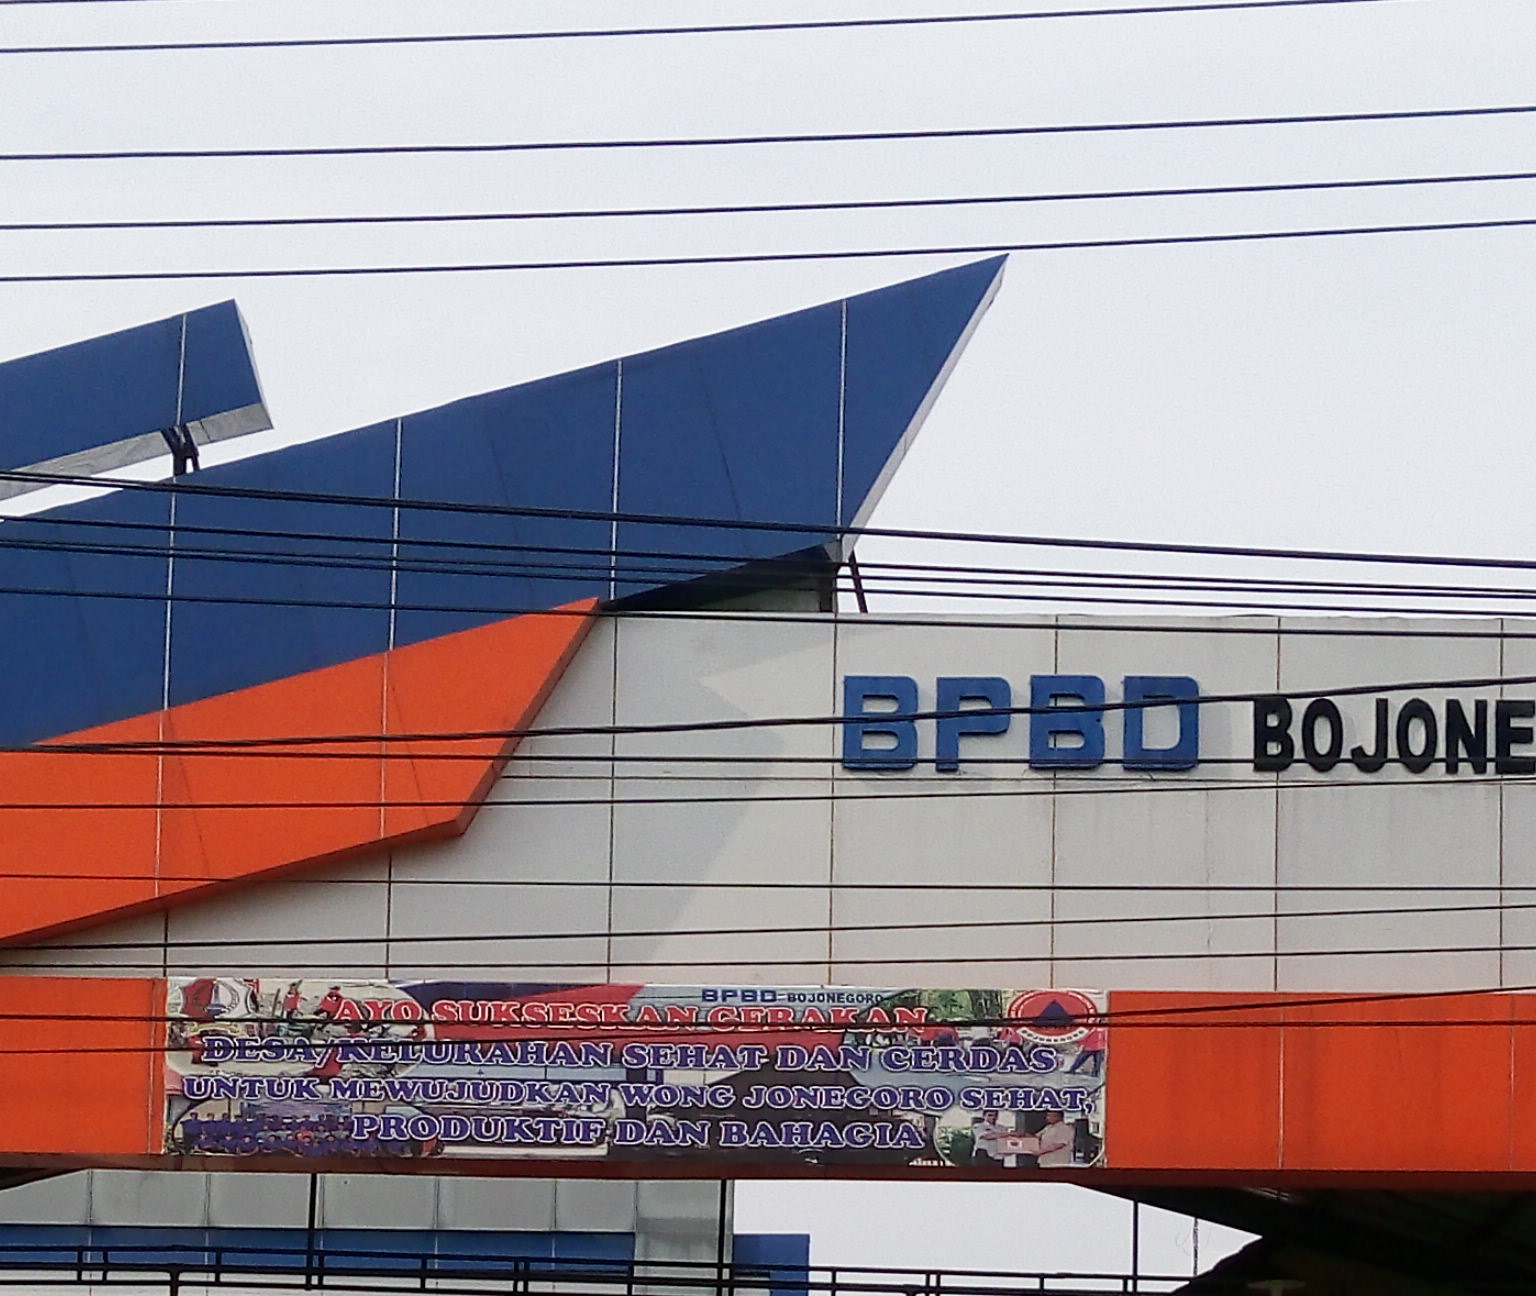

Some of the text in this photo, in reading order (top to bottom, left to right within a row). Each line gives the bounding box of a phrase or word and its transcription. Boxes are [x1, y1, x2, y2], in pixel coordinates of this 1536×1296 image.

[842, 674, 1200, 773] BPBD
[334, 998, 929, 1034] AYO SUKSESKAN GERAKAN
[701, 989, 885, 1005] BPBD BOJONEGORO
[201, 1035, 1058, 1074] DESA/KELURAHAN SEHAT DAN CERDAS
[182, 1076, 1095, 1115] UNTUK MEWUJUDKAN WONG JONEGORO SEHAT,
[351, 1113, 926, 1150] PRODUKTIF DAN BAHAGIA
